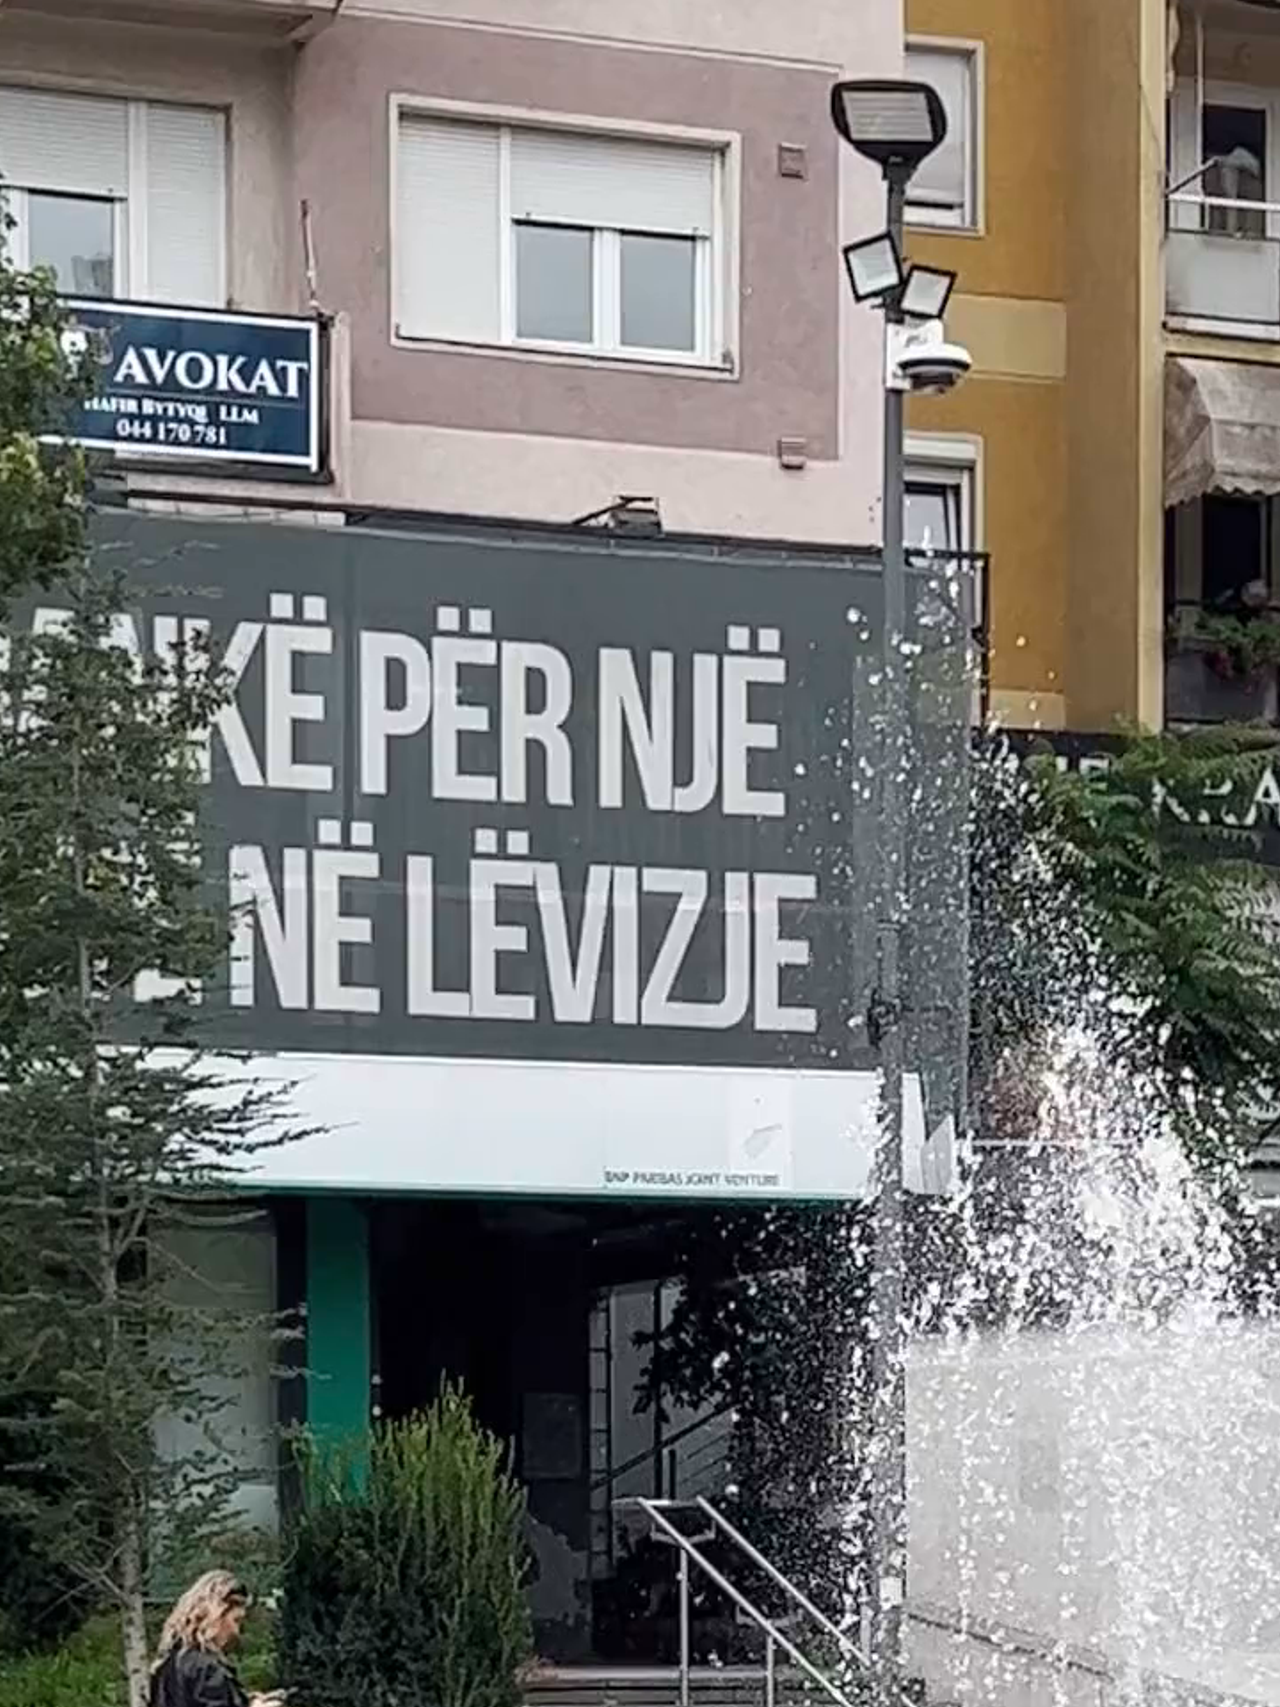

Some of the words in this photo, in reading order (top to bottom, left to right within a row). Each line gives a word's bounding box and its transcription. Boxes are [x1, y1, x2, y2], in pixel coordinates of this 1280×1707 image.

[113, 345, 308, 398] AVOKAT
[116, 419, 151, 438] 044
[360, 606, 574, 806] PËR
[599, 626, 787, 817] NJË
[229, 819, 380, 1014] NË
[407, 829, 817, 1032] LËVIZJE
